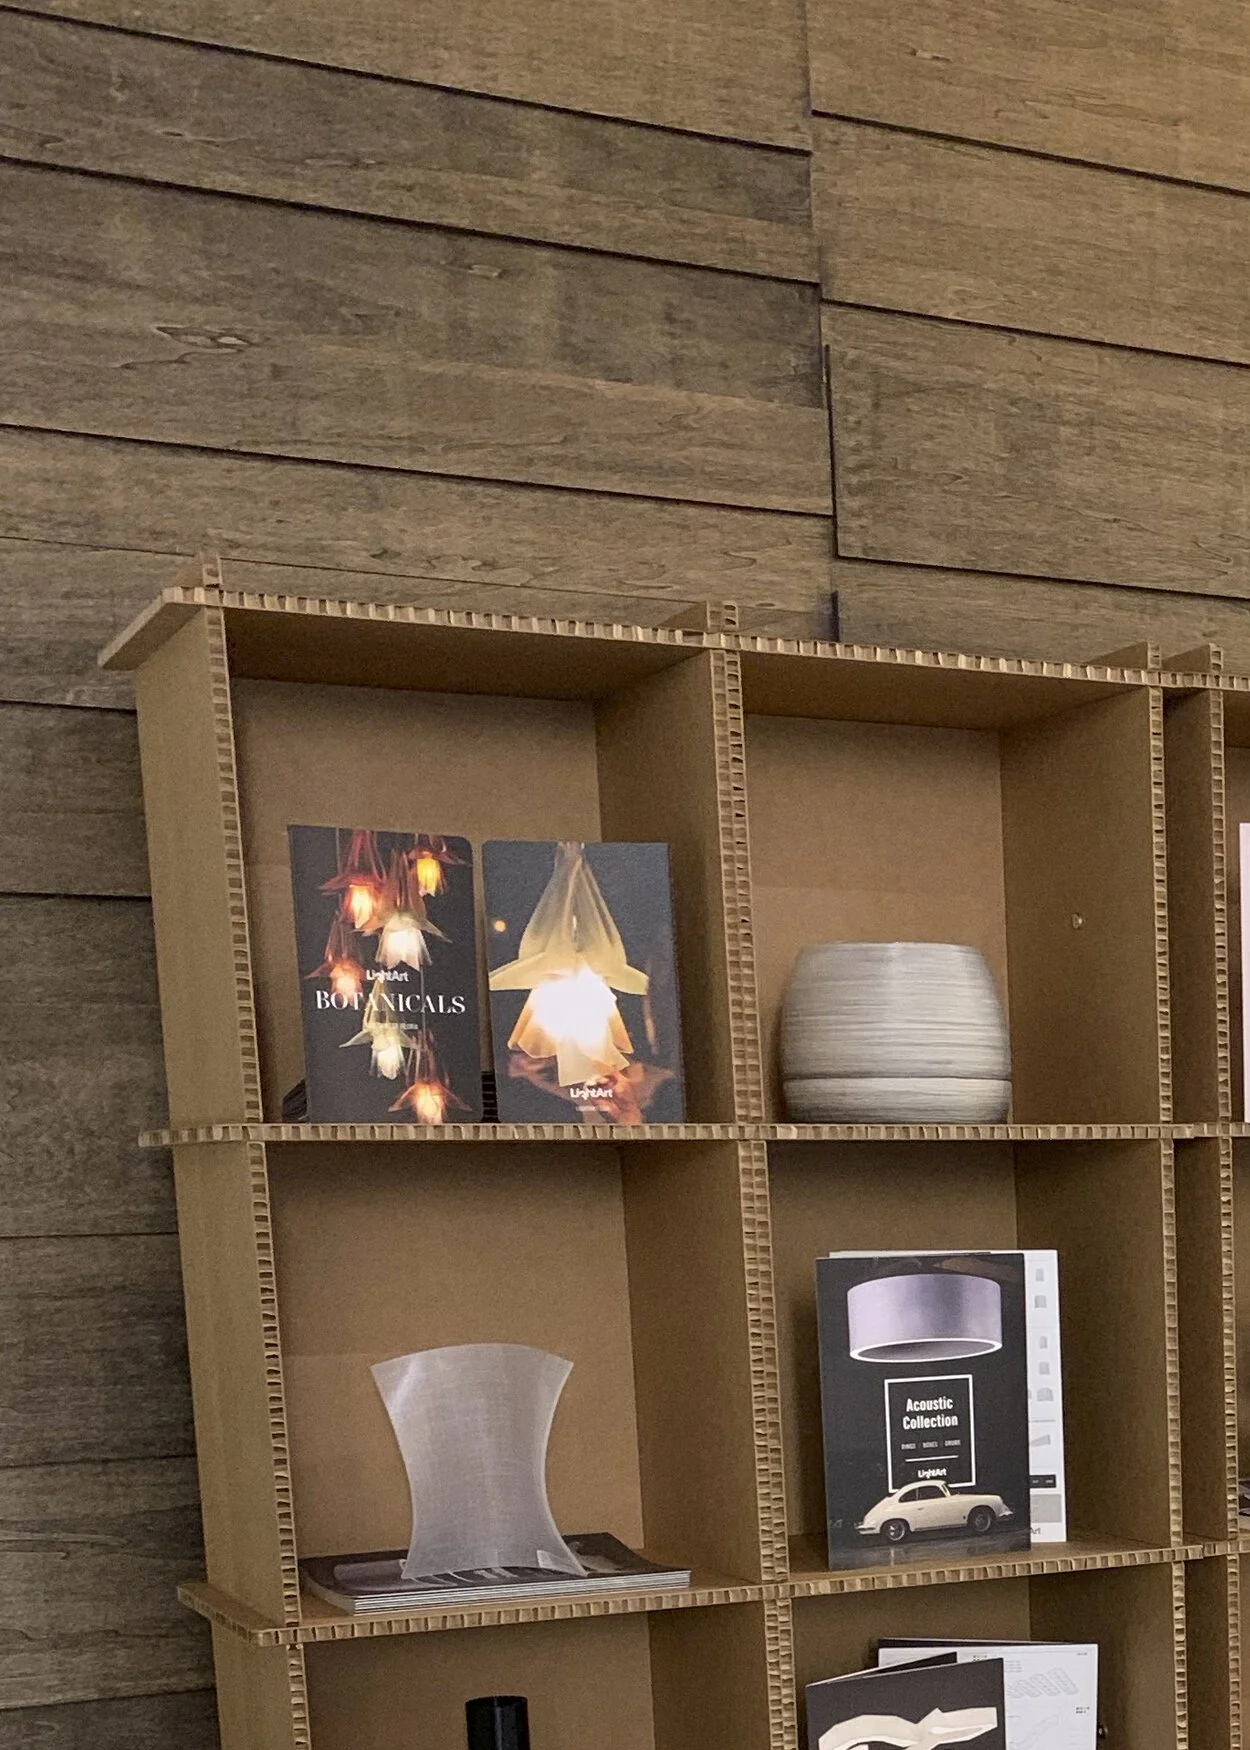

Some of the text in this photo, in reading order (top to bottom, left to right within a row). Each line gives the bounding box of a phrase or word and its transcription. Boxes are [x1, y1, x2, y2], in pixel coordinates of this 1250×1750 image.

[366, 969, 409, 984] LightArt
[315, 990, 466, 1014] BOTANICALS
[570, 1087, 613, 1100] LightArt
[906, 1395, 954, 1412] Acoustic
[902, 1413, 959, 1430] Collection
[917, 1468, 947, 1479] LightArt
